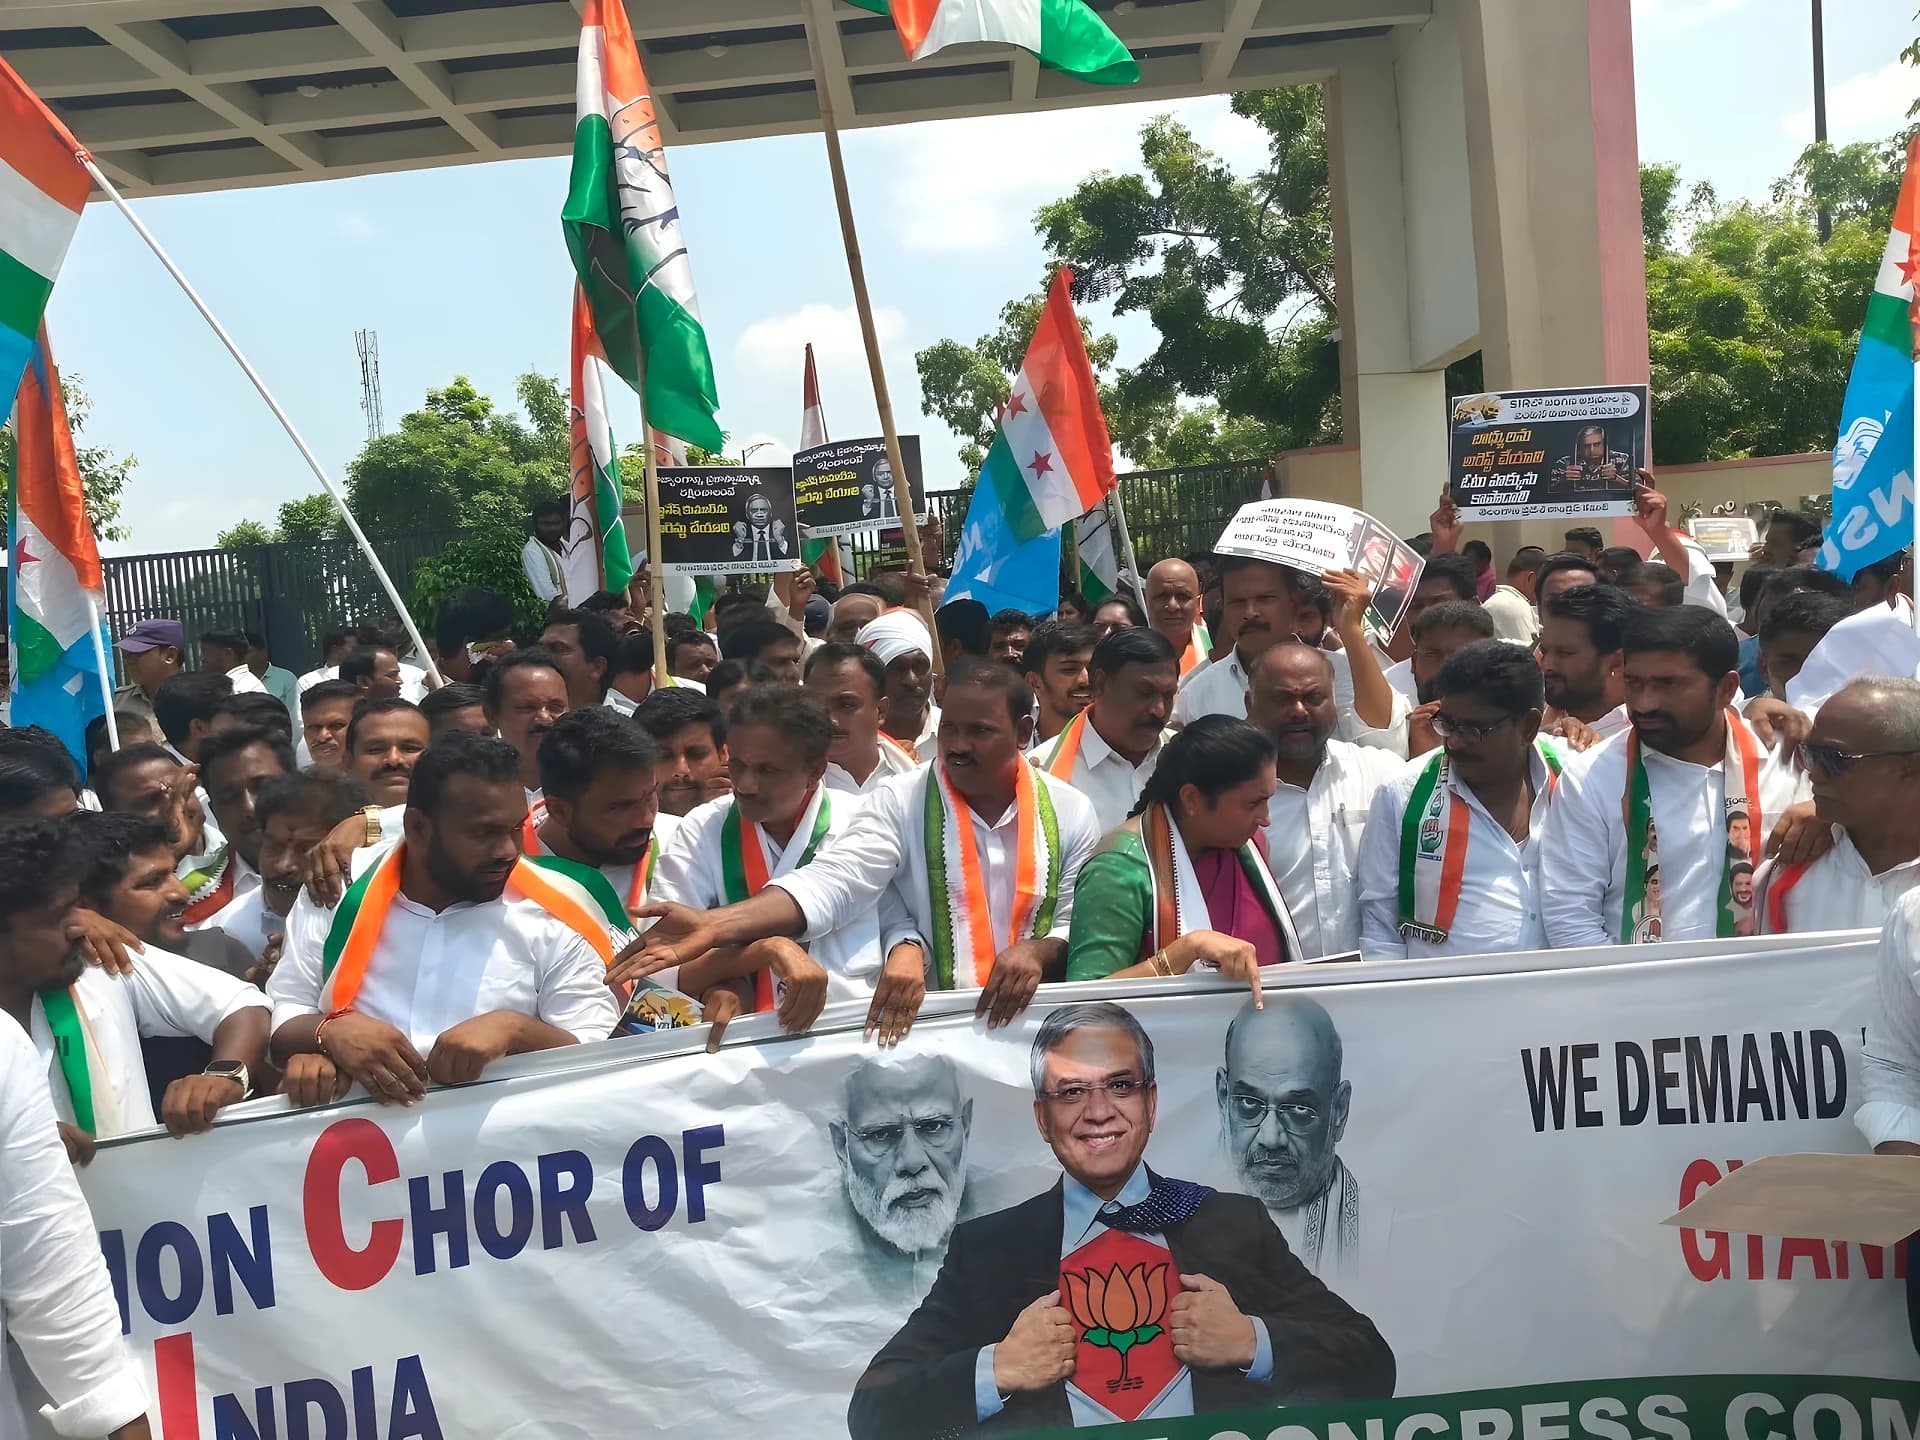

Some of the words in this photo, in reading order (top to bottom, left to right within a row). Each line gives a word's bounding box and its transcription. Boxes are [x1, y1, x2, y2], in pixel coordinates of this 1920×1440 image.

[1460, 473, 1487, 489] ఓటు
[1520, 1043, 1604, 1132] WE
[1615, 1029, 1848, 1127] DEMAND
[303, 1117, 598, 1291] CHOR
[622, 1124, 726, 1233] OF
